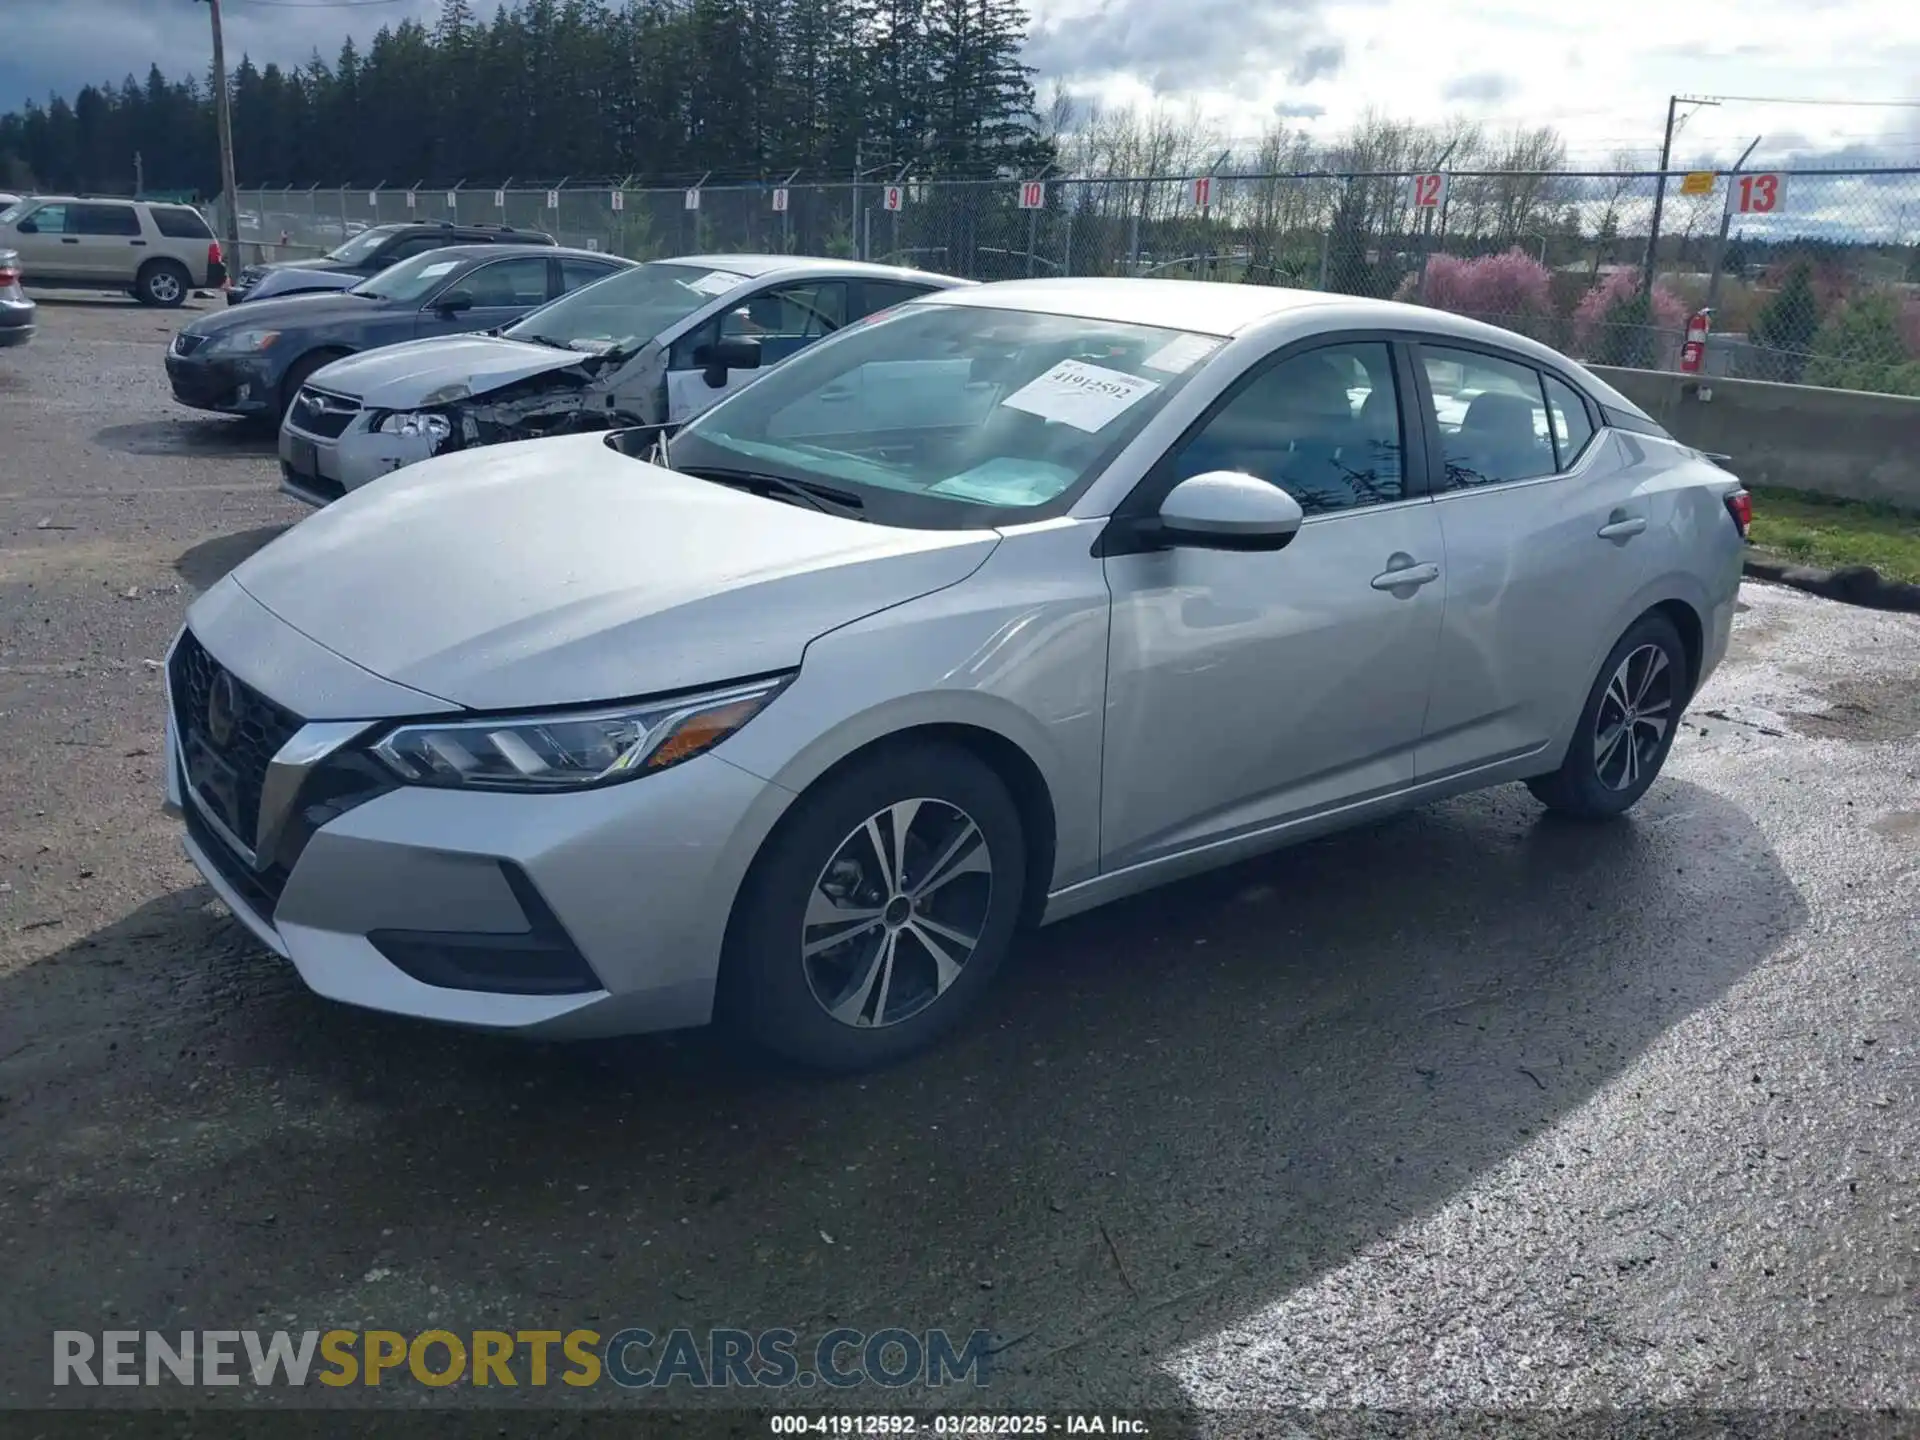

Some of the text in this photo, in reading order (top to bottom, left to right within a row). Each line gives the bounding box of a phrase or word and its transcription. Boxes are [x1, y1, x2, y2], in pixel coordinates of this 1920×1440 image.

[888, 187, 898, 209] 9
[1023, 183, 1041, 207] 10
[1195, 177, 1210, 206] 11
[1414, 175, 1442, 205] 12
[1739, 174, 1779, 214] 13
[1052, 372, 1132, 399] 41912592
